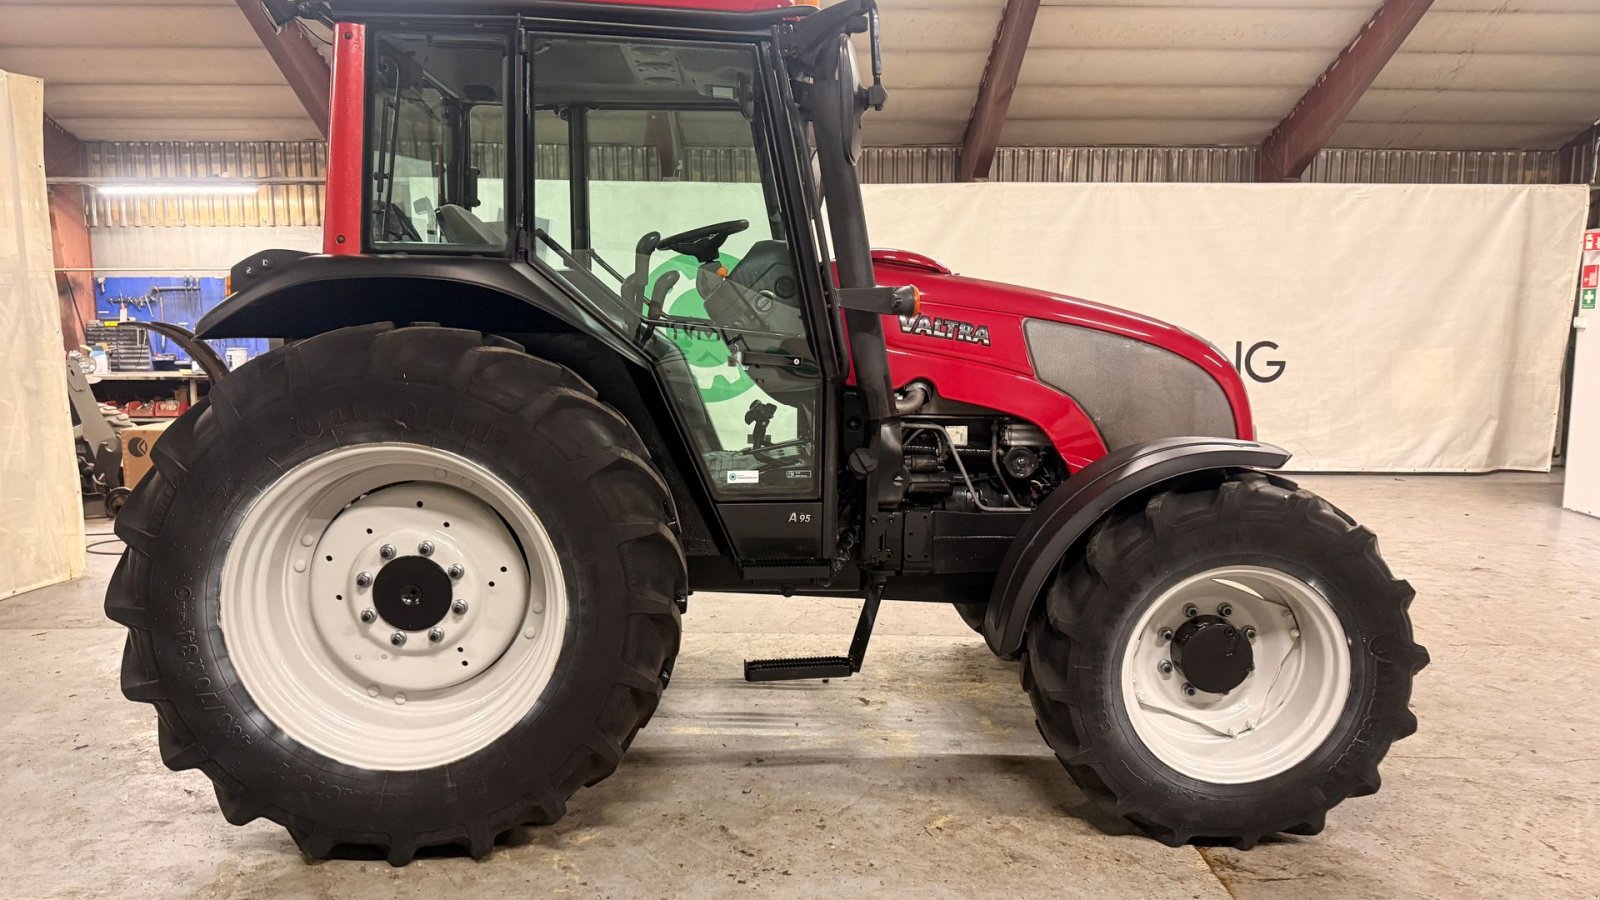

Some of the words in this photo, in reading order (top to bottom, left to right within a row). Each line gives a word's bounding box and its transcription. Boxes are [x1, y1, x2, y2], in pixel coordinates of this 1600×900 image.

[898, 313, 991, 347] VALTRA
[788, 512, 797, 523] A
[799, 514, 811, 523] 95
